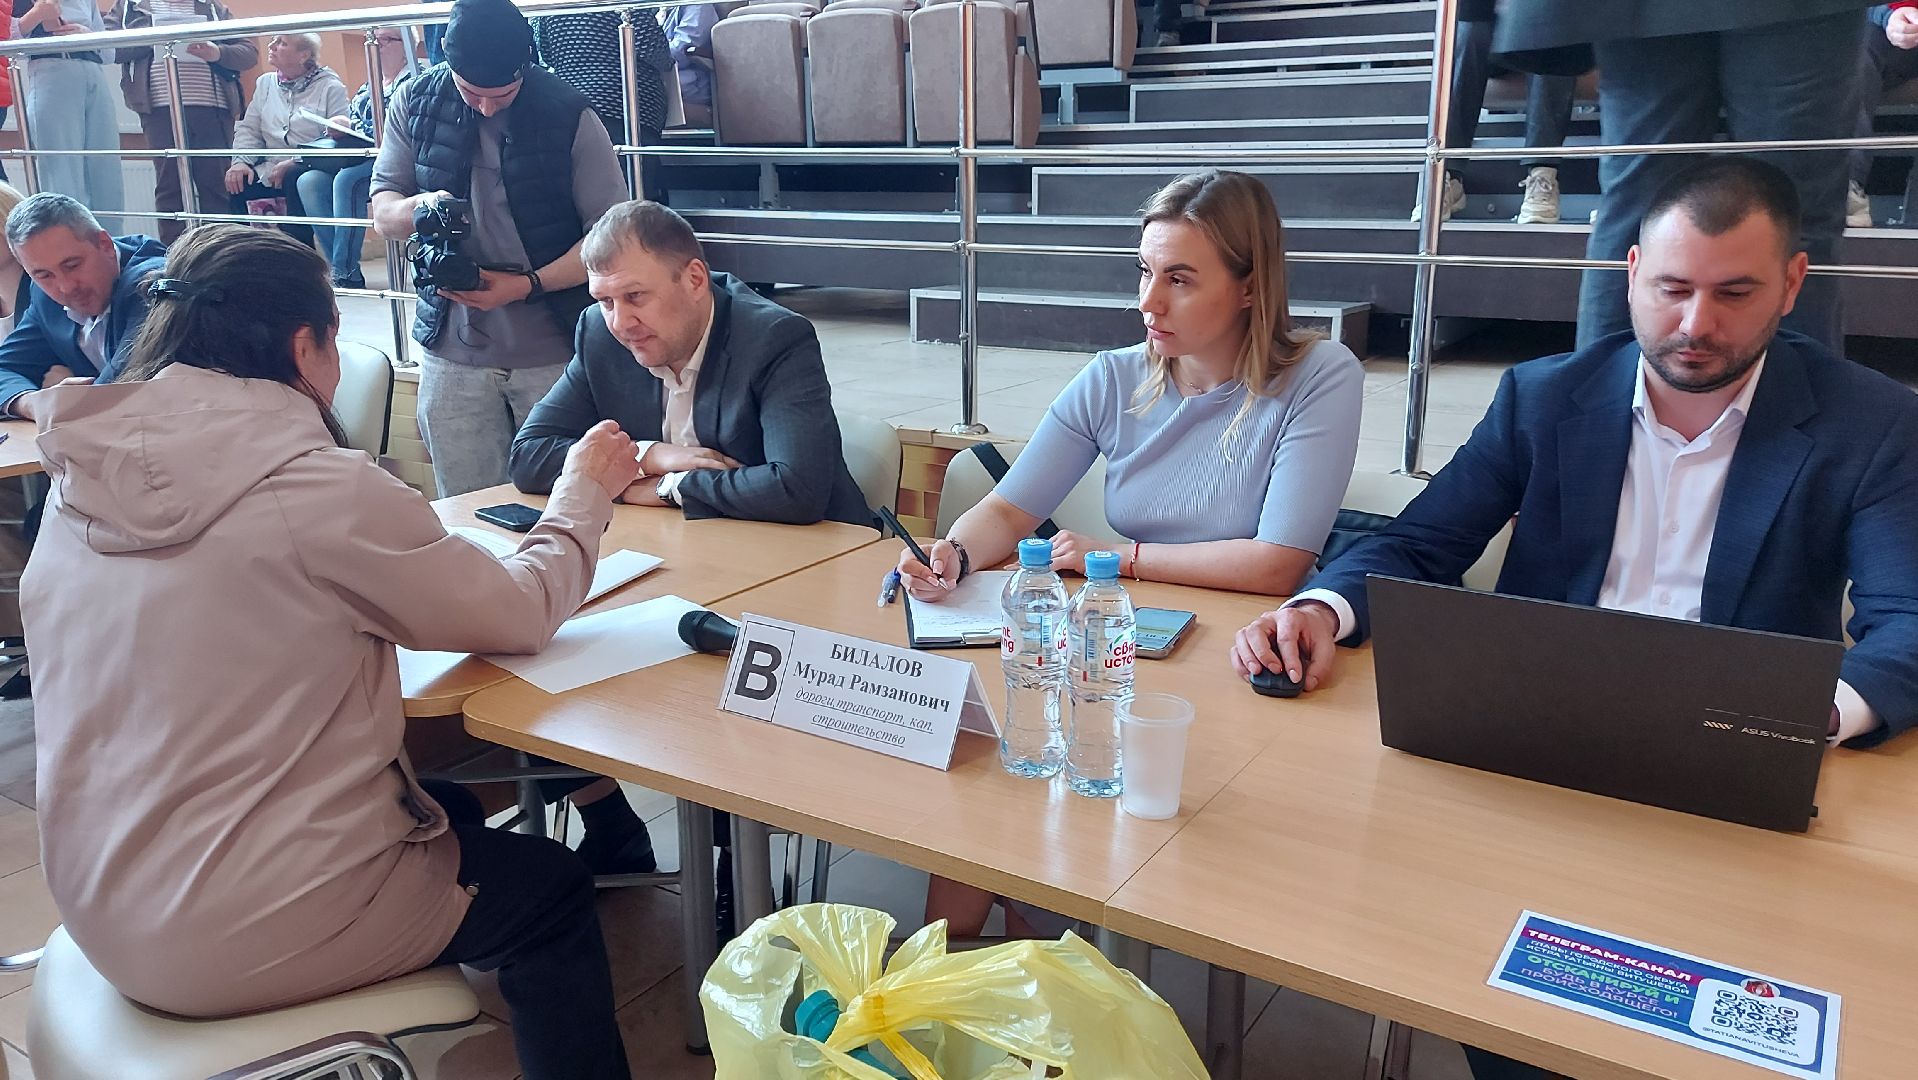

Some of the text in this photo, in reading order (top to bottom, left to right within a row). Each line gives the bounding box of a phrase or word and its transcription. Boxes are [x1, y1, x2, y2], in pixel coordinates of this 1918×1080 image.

[830, 643, 923, 677] БИЛАЛОВ
[793, 661, 950, 712] Мурад Рамзанович
[812, 714, 906, 745] строительство
[909, 717, 934, 732] кап.
[1741, 727, 1769, 737] ASUS
[1526, 944, 1690, 995] ИСТРА ТАТЬЯНЫ ВИТУШЕВОЙ
[1528, 929, 1691, 981] ТЕЛЕГРАМ-КАНАЛ
[1531, 940, 1688, 989] ГЛАВЫ ГОРОДСКОГО ОКРУГА
[1521, 967, 1678, 1019] ПРОИСХОДЯЩЕГО!
[1527, 955, 1680, 1005] ОТСКАНИРУЙ И
[1543, 967, 1659, 1006] БУДЬ В КУРСЕ
